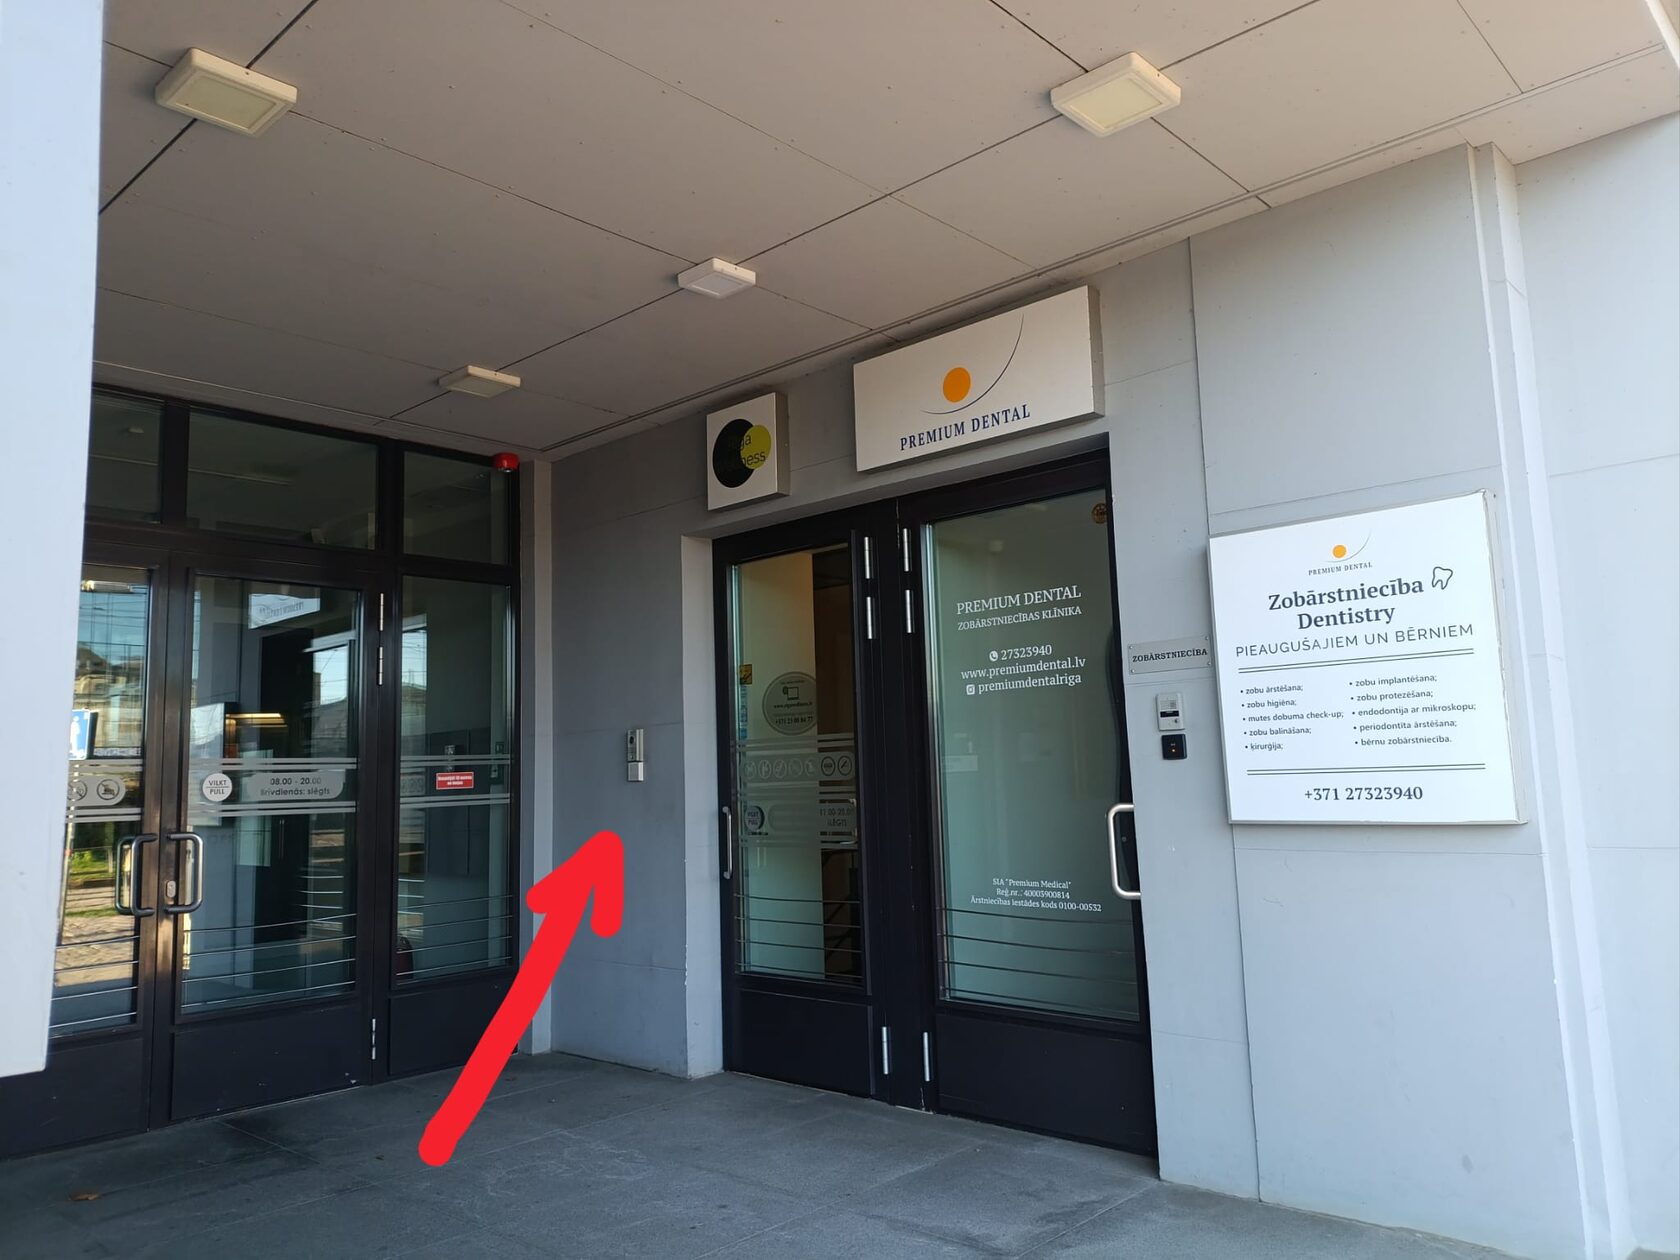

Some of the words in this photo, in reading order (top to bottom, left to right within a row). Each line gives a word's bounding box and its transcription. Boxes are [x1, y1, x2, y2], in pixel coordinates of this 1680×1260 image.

[900, 422, 965, 451] PREMIUM
[972, 404, 1030, 432] DENTAL
[1309, 566, 1341, 576] PREMIUM
[1345, 562, 1372, 571] DENTAL
[957, 594, 1020, 614] PREMIUM
[1024, 586, 1081, 605] DENTAL
[1269, 578, 1424, 610] Zobārstniecība
[958, 612, 1039, 630] ZOBĀRSTNIECĪBAS
[1042, 606, 1082, 620] KLĪNIKA
[1297, 607, 1395, 630] Dentistry
[1236, 634, 1358, 657] PIEAUGUŠAJIEM
[1364, 632, 1388, 645] UN
[1395, 624, 1474, 642] BĒRNIEM
[1001, 645, 1052, 660] 27323940
[1132, 648, 1208, 662] ZOBĀRSTNIECĪBA
[961, 657, 1085, 679] www.premiumdental.lv
[978, 674, 1082, 694] premiumdentalriga
[1355, 679, 1375, 687] zobu
[1306, 711, 1344, 719] check-up;
[1358, 708, 1408, 716] endodontija
[1422, 704, 1476, 712] mikroskopu;
[1304, 788, 1339, 801] +371
[1345, 786, 1423, 800] 27323940
[1041, 900, 1057, 909] kods
[1059, 903, 1102, 912] 0100-00532
